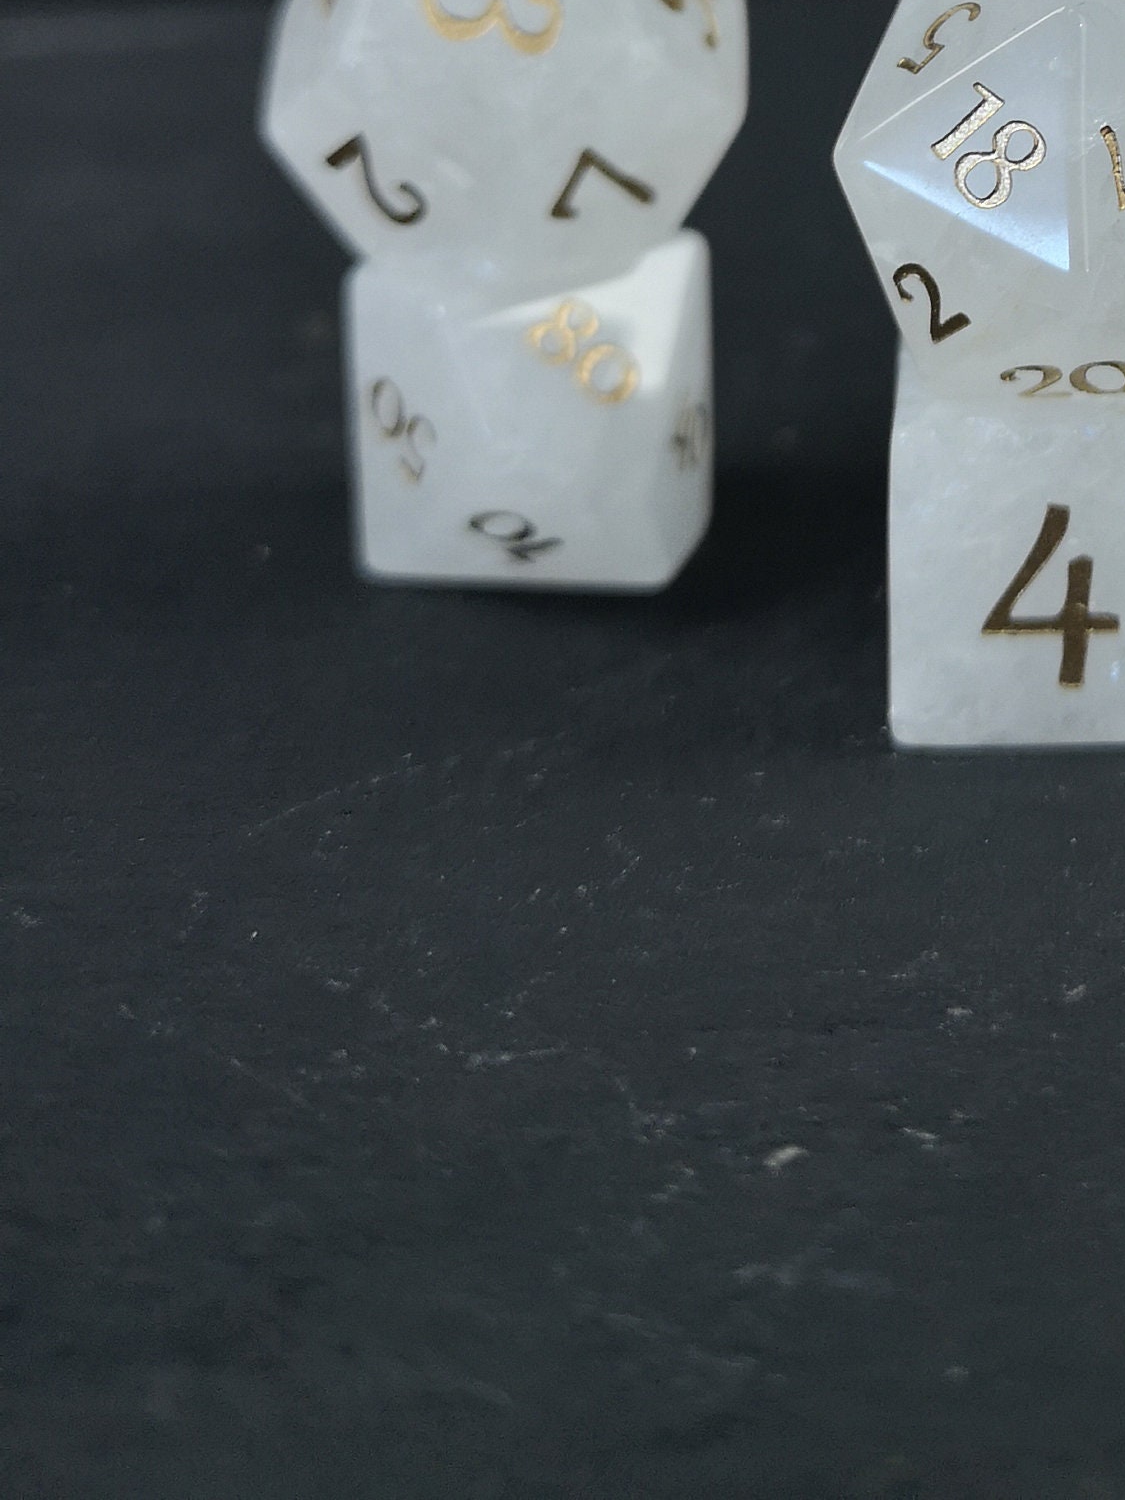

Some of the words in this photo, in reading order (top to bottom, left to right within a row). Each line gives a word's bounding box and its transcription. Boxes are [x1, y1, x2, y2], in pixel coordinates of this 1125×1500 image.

[897, 2, 981, 74] 5
[326, 133, 428, 226] 2
[551, 148, 656, 220] 7
[931, 82, 1047, 209] 18
[893, 263, 971, 343] 2
[527, 298, 641, 408] 80
[981, 503, 1121, 688] 4
